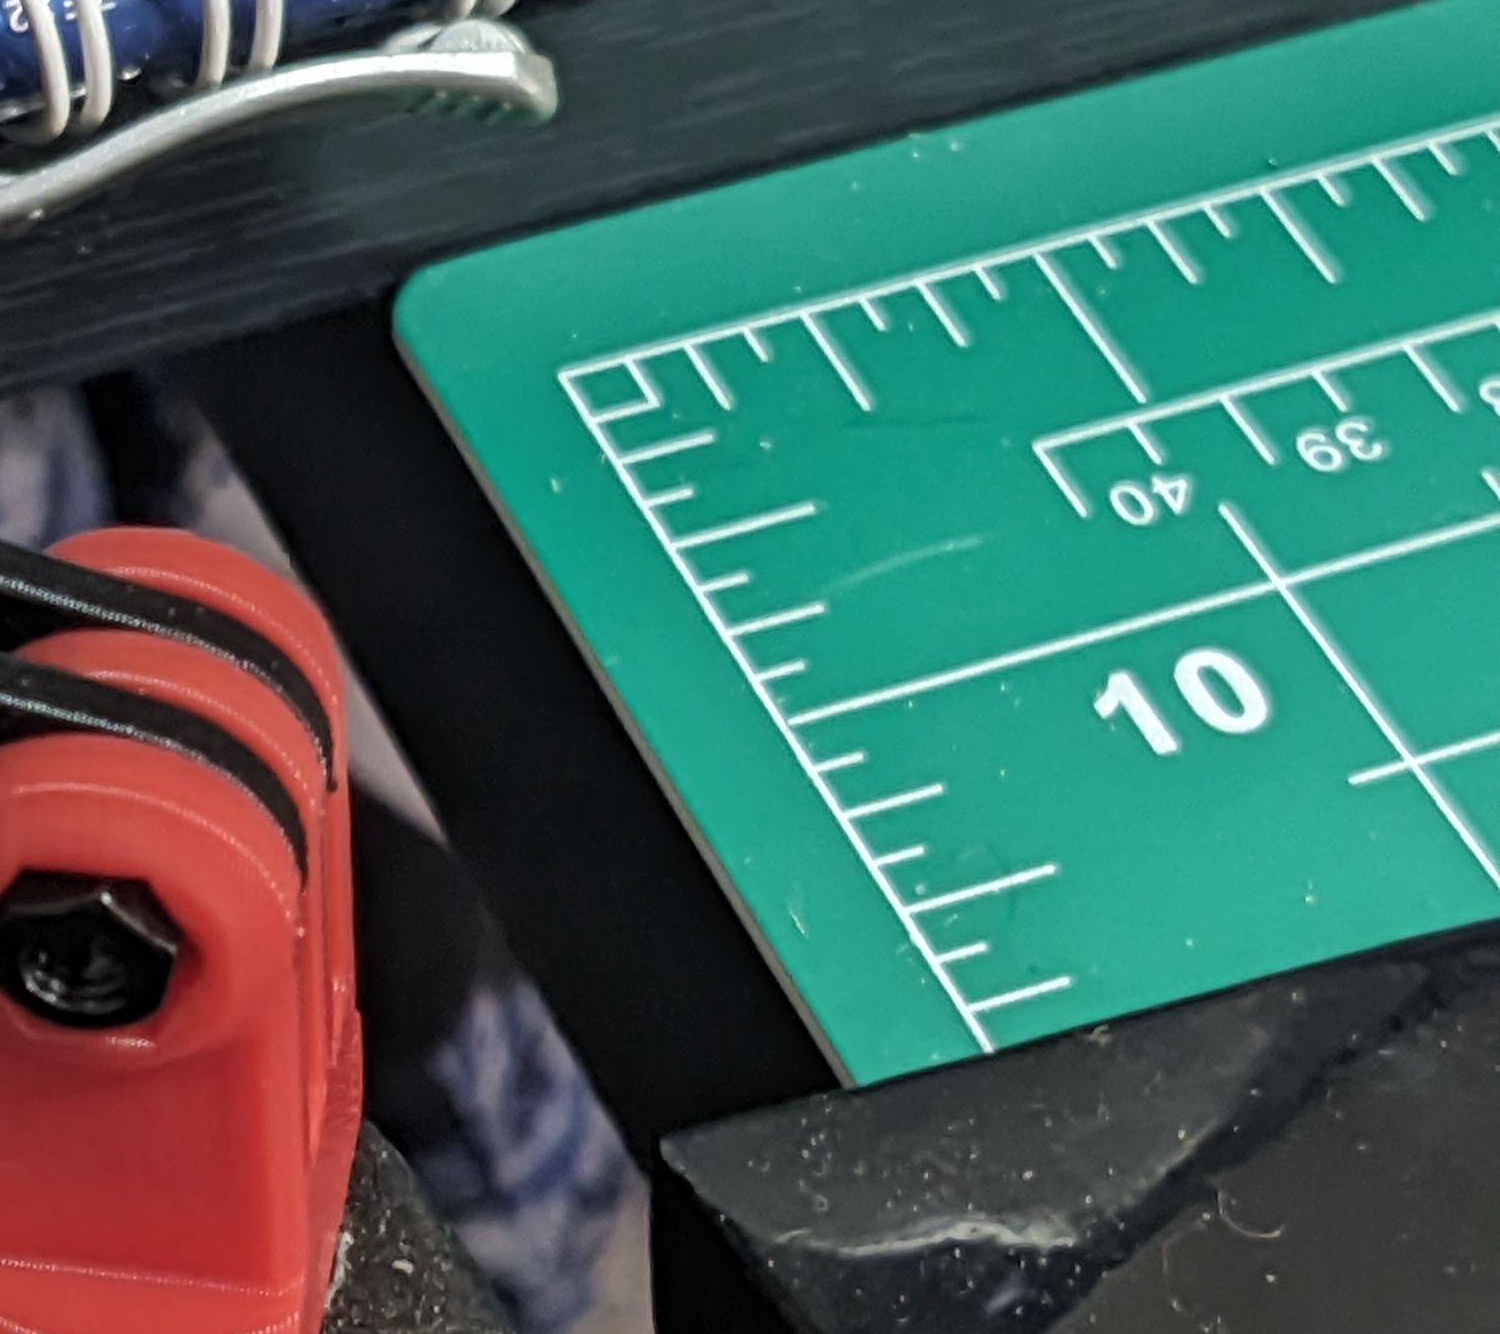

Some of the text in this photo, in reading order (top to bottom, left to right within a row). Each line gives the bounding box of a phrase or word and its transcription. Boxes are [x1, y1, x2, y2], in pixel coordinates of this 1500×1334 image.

[1296, 416, 1387, 473] 39
[1109, 473, 1191, 527] 40
[1094, 649, 1269, 756] 10
